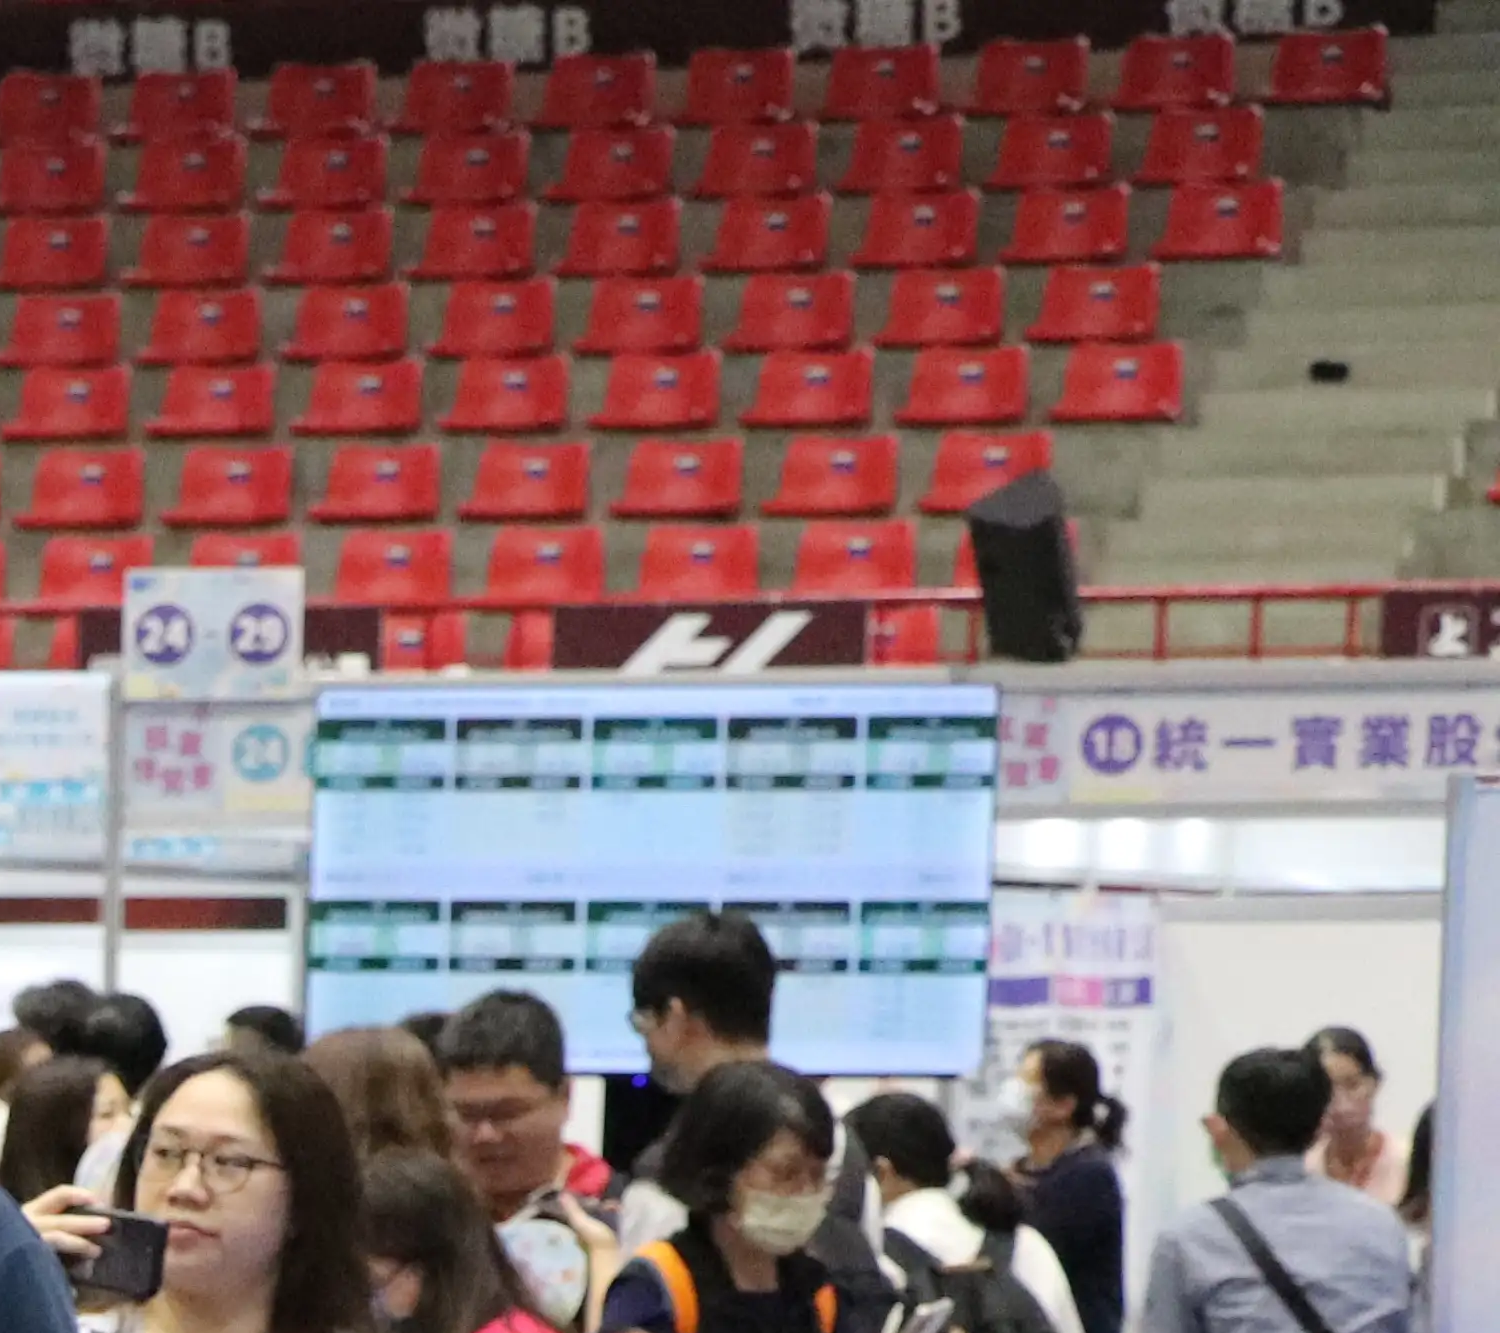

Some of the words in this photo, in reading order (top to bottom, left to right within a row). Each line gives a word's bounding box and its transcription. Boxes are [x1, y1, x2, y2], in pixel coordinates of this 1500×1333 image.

[138, 611, 190, 655] 24
[1154, 713, 1500, 773] 統一實業股
